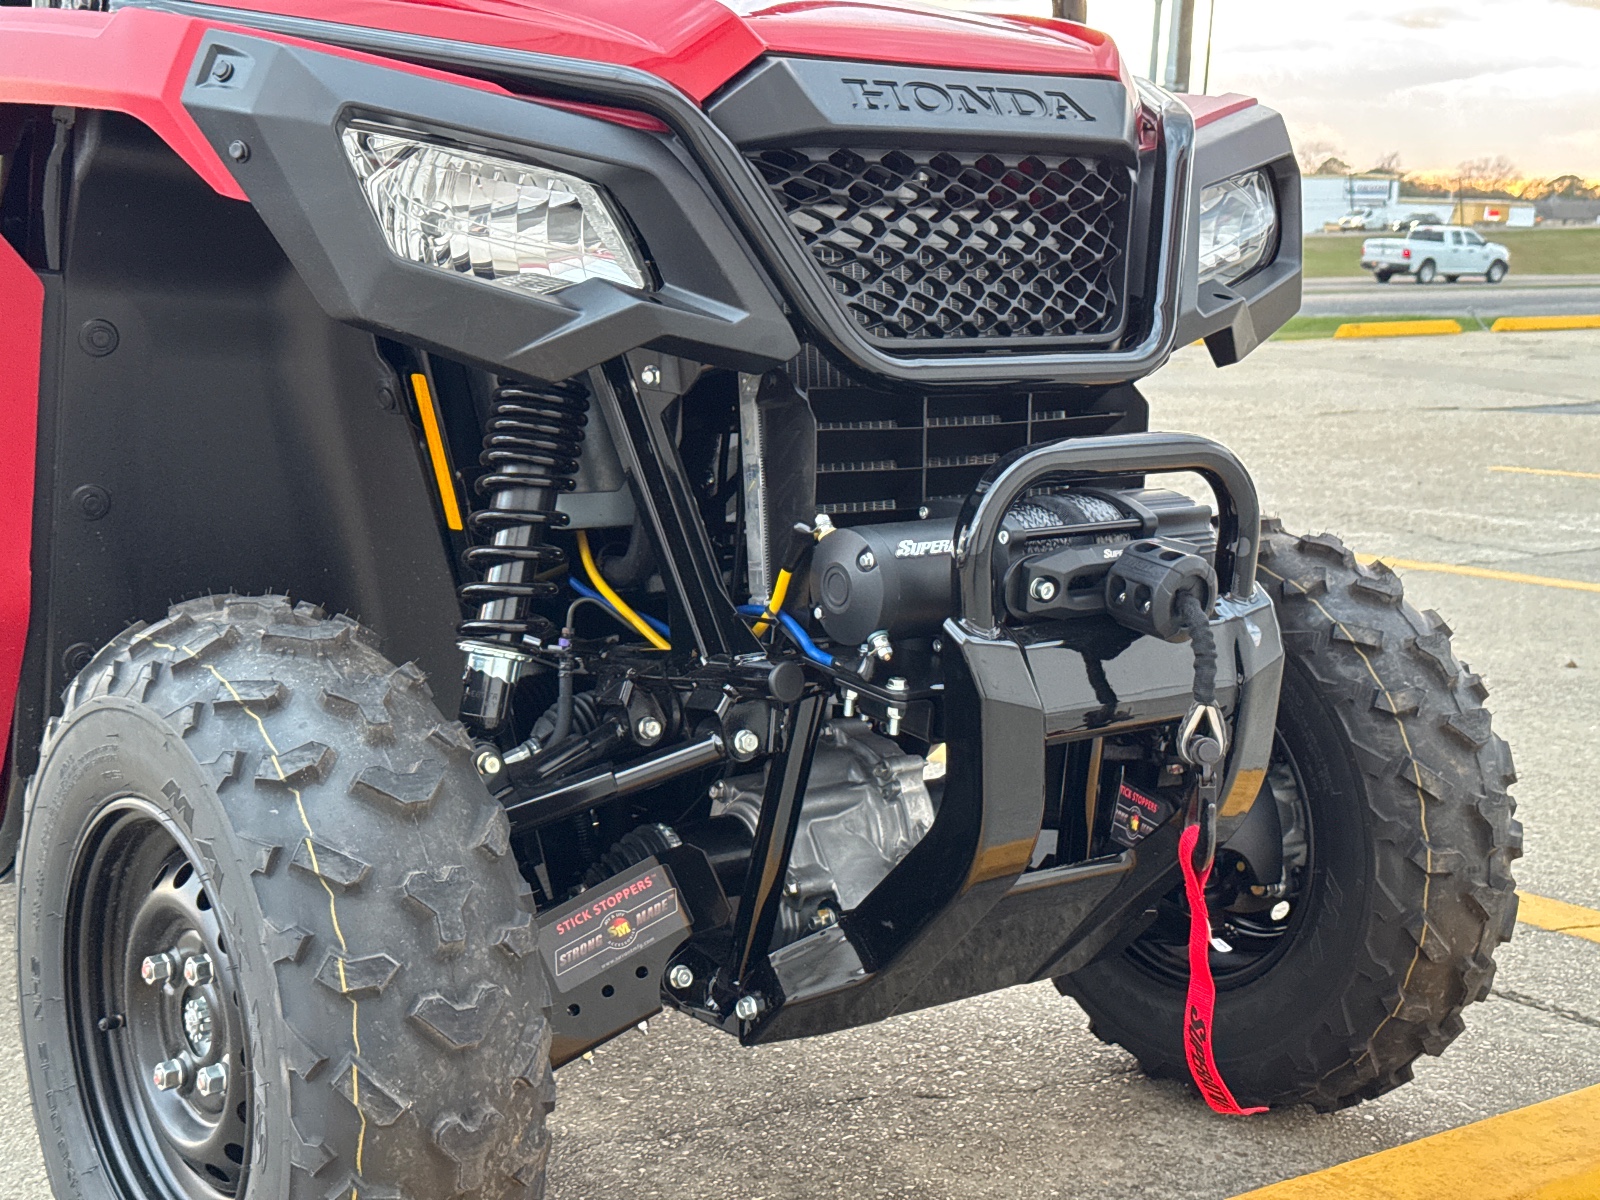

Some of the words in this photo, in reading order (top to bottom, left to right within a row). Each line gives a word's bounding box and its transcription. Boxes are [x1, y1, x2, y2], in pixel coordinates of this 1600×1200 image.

[841, 78, 1096, 122] HONDA
[556, 909, 592, 936] STICK
[559, 934, 603, 967] STRONG
